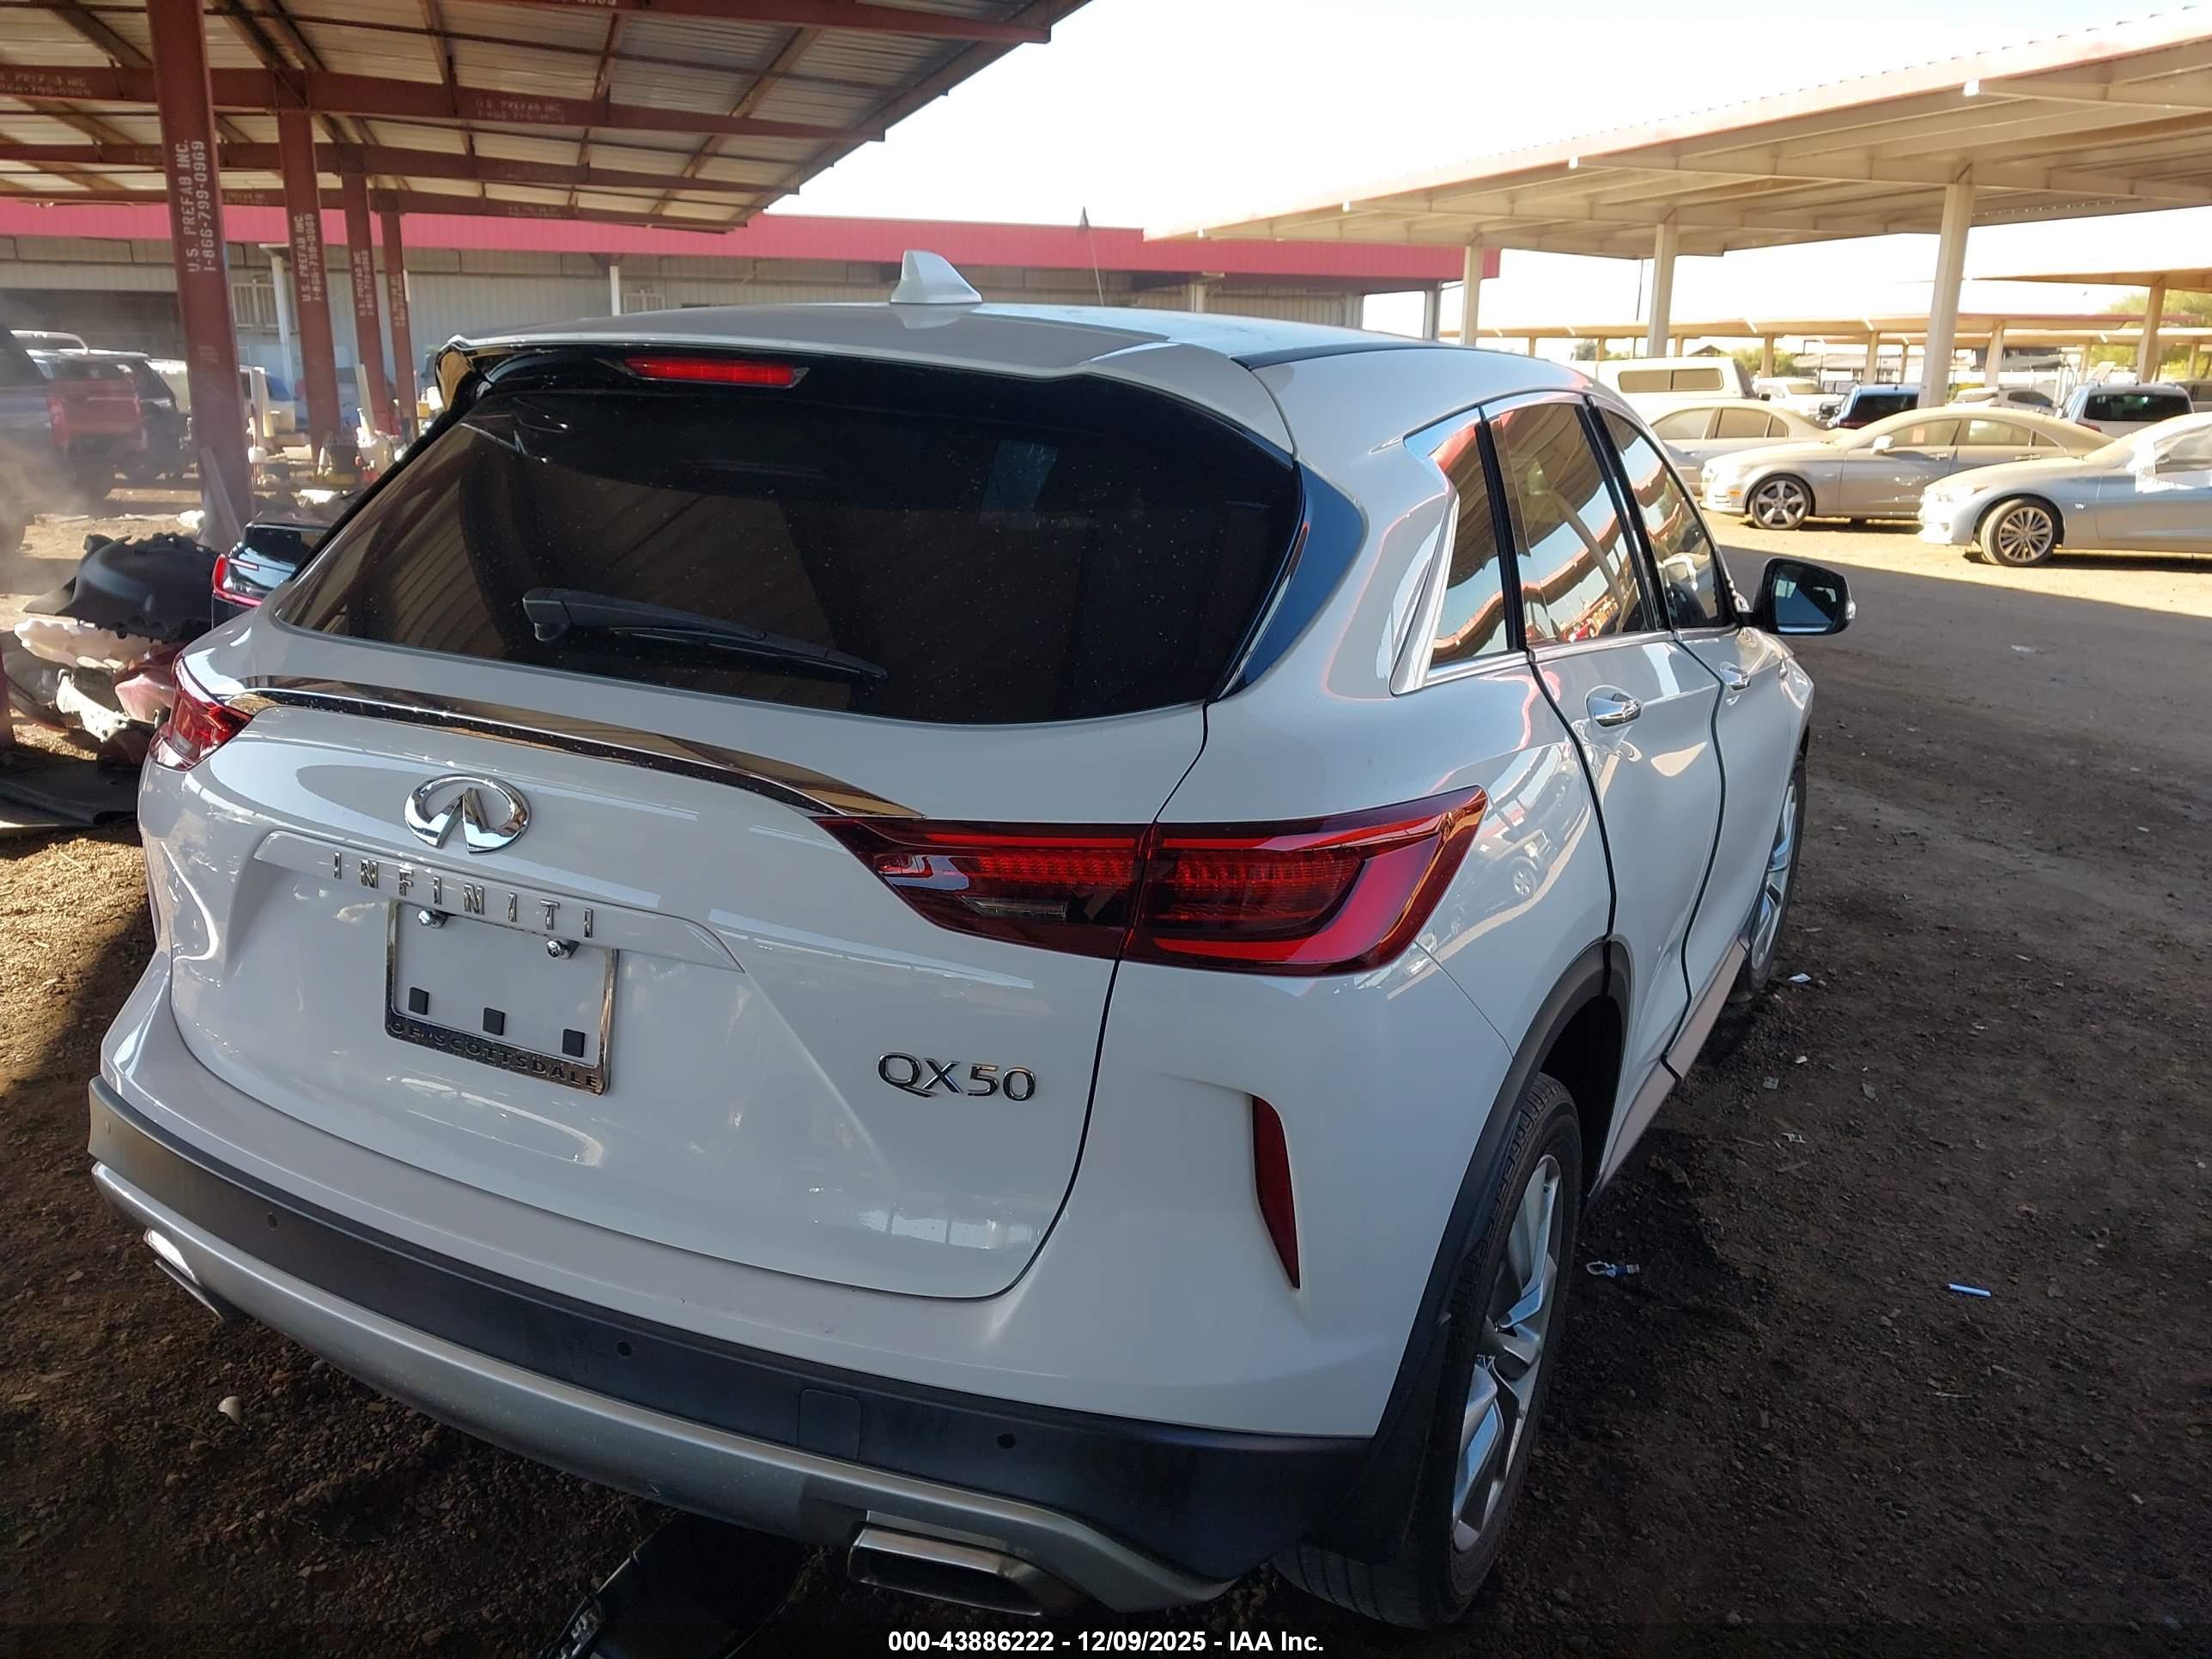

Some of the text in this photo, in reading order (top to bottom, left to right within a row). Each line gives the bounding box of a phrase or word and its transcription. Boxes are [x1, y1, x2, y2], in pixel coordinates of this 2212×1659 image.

[175, 139, 200, 272] U.S. PREFAB INC.
[191, 140, 217, 271] 1-866-799-0969
[295, 236, 310, 278] PREFAB
[333, 851, 593, 939] INFINITI
[434, 1032, 599, 1089] SCOTTSDALE
[877, 1051, 1036, 1102] QX50
